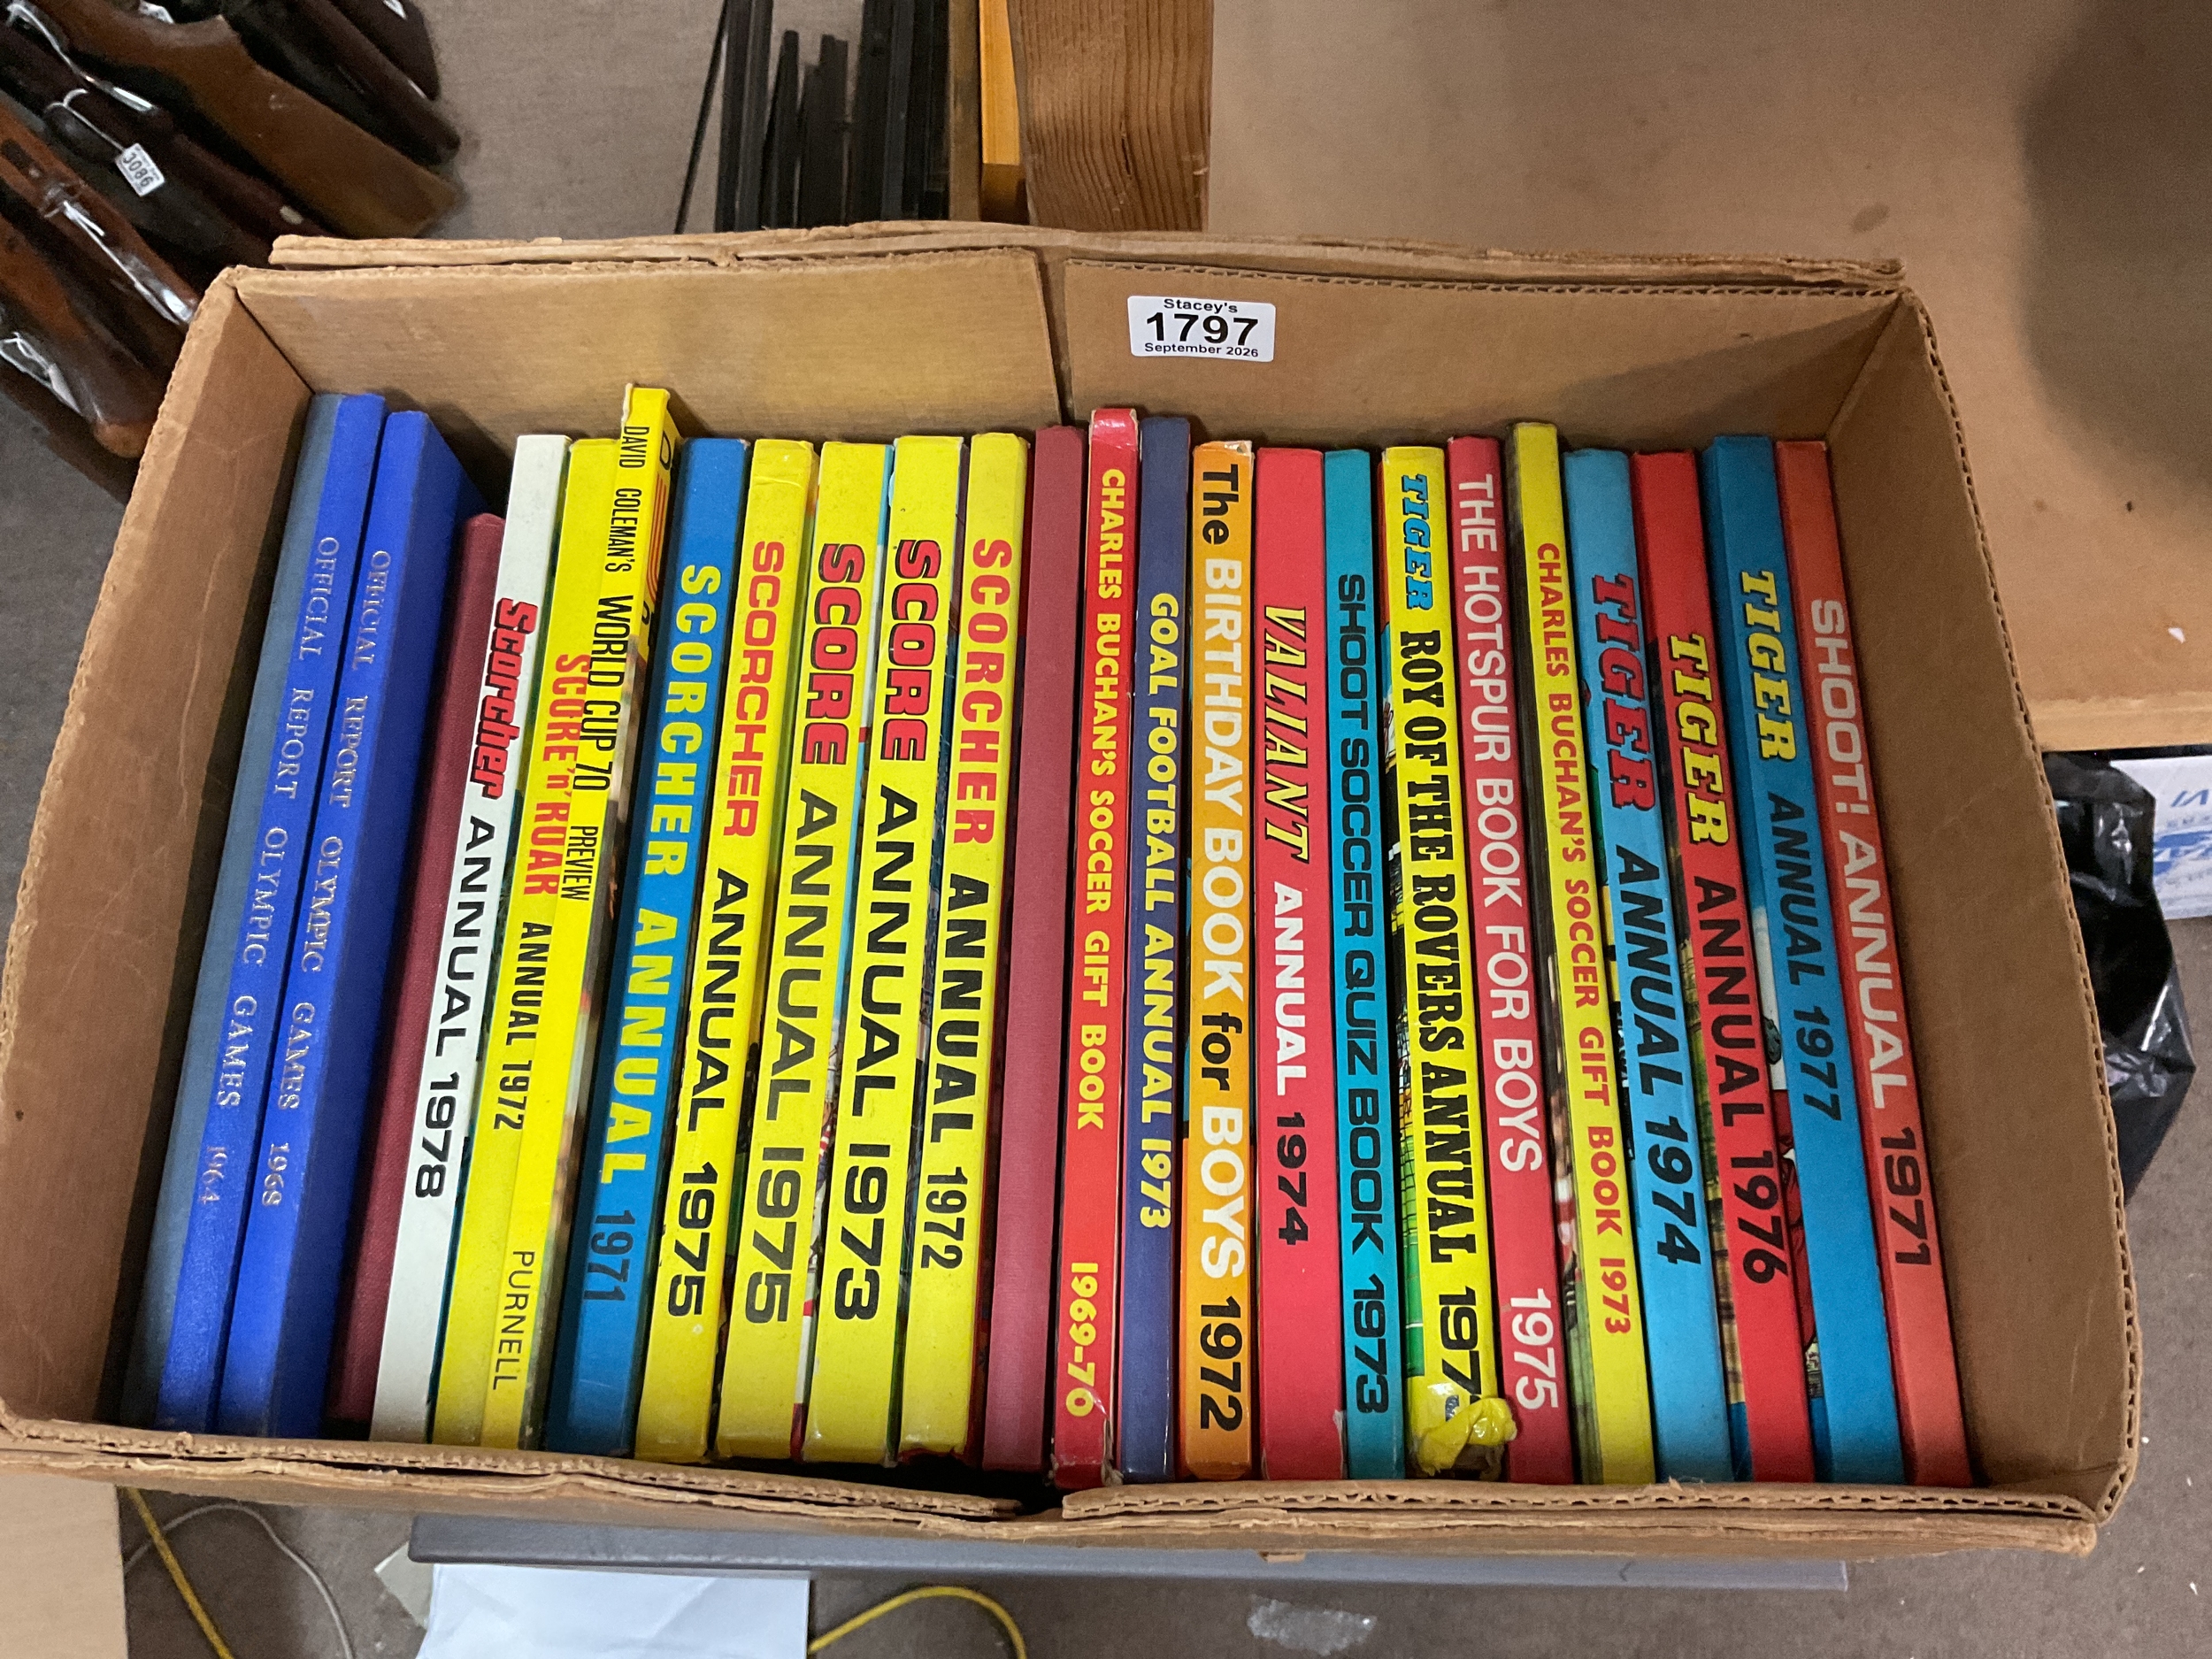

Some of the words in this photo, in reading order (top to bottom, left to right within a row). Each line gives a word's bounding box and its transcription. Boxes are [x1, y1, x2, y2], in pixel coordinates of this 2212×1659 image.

[1144, 342, 1222, 354] September
[1226, 346, 1259, 357] 2026
[1147, 312, 1258, 346] 1797
[1164, 298, 1238, 314] Stacey's
[619, 426, 649, 469] DAVID
[1202, 465, 1239, 545] The
[1458, 474, 1497, 552] THE
[299, 536, 340, 660] OFFICIAL
[604, 488, 642, 572] COLEMAN'S
[1099, 468, 1125, 599] CHARLES
[1401, 474, 1433, 611] TIGER
[355, 550, 391, 664] OFFICIAL
[588, 595, 634, 687] WORLD
[801, 542, 864, 765] SCORE
[880, 539, 941, 761] SCORE
[1148, 593, 1179, 695] GOAL
[1338, 574, 1368, 731] SHOOT
[1401, 630, 1443, 709] ROY
[1463, 565, 1510, 762] HOTSPUR
[1537, 542, 1569, 677] CHARLES
[1740, 570, 1797, 762] TIGER
[273, 687, 314, 799] REPORT
[329, 695, 368, 808] REPORT
[470, 598, 538, 800] Scorcher
[543, 654, 591, 762] SCORE
[580, 700, 621, 752] CUP
[644, 565, 722, 876] SCORCHER
[724, 541, 785, 837] SCORCHER
[953, 539, 1013, 845] SCORCHER
[1091, 613, 1121, 776] BUCHAN'S
[1204, 559, 1243, 816] BIRTHDAY
[1263, 605, 1310, 864] VALIANT
[1403, 716, 1447, 772] OF
[1592, 572, 1656, 811] TIGER
[1668, 633, 1730, 845] TIGER
[1811, 599, 1870, 815] SHOOT!
[572, 761, 613, 791] 70
[1144, 709, 1178, 910] FOOTBALL
[1340, 738, 1373, 937] SOCCER
[1408, 774, 1452, 864] THE
[1477, 779, 1522, 908] BOOK
[1550, 692, 1586, 863] BUCHAN'S
[242, 826, 288, 967] OLYMPIC
[301, 836, 343, 972] OLYMPIC
[560, 826, 599, 902] PREVIEW
[1086, 789, 1115, 914] SOCCER
[1202, 827, 1243, 1002] BOOK
[1769, 790, 1825, 986] ANNUAL
[435, 816, 495, 1057] ANNUAL
[506, 921, 552, 1046] ANNUAL
[687, 868, 749, 1132] ANNUAL
[766, 788, 838, 1121] ANNUAL
[852, 784, 918, 1117] ANNUAL
[1083, 930, 1110, 1007] GIFT
[1273, 881, 1307, 1096] ANNUAL
[1412, 872, 1464, 1053] ROVERS
[1486, 926, 1529, 1020] FOR
[1565, 879, 1600, 1009] SOCCER
[1616, 845, 1682, 1096] ANNUAL
[1694, 877, 1764, 1127] ANNUAL
[1839, 831, 1907, 1109] ANNUAL
[217, 995, 257, 1109] GAMES
[278, 1002, 315, 1110] GAMES
[601, 909, 678, 1184] ANNUAL
[931, 873, 989, 1143] ANNUAL
[1141, 924, 1174, 1124] ANNUAL
[1201, 1012, 1242, 1091] for
[1345, 950, 1378, 1076] QUIZ
[1578, 1027, 1610, 1107] GIFT
[1794, 1006, 1840, 1122] 1977
[415, 1071, 458, 1198] 1978
[494, 1060, 532, 1131] 1972
[1077, 1024, 1106, 1131] BOOK
[1494, 1038, 1543, 1172] BOYS
[198, 1146, 227, 1203] 1964
[262, 1143, 290, 1207] 1968
[921, 1166, 969, 1269] 1972
[1141, 1138, 1171, 1229] 1973
[1200, 1105, 1245, 1279] BOYS
[1276, 1112, 1310, 1246] 1974
[1348, 1087, 1385, 1255] BOOK
[1421, 1062, 1478, 1263] ANNUAL
[1587, 1125, 1624, 1236] BOOK
[1646, 1117, 1701, 1265] 1974
[1730, 1149, 1788, 1285] 1976
[1880, 1127, 1932, 1266] 1971
[583, 1210, 636, 1302] 1971
[668, 1162, 715, 1317] 1975
[745, 1147, 804, 1324] 1975
[834, 1143, 890, 1321] 1973
[1600, 1257, 1632, 1334] 1973
[492, 1250, 534, 1390] PURNELL
[1065, 1263, 1098, 1417] 1969-70
[1200, 1296, 1243, 1432] 1972
[1353, 1274, 1389, 1415] 1973
[1509, 1287, 1559, 1410] 1975
